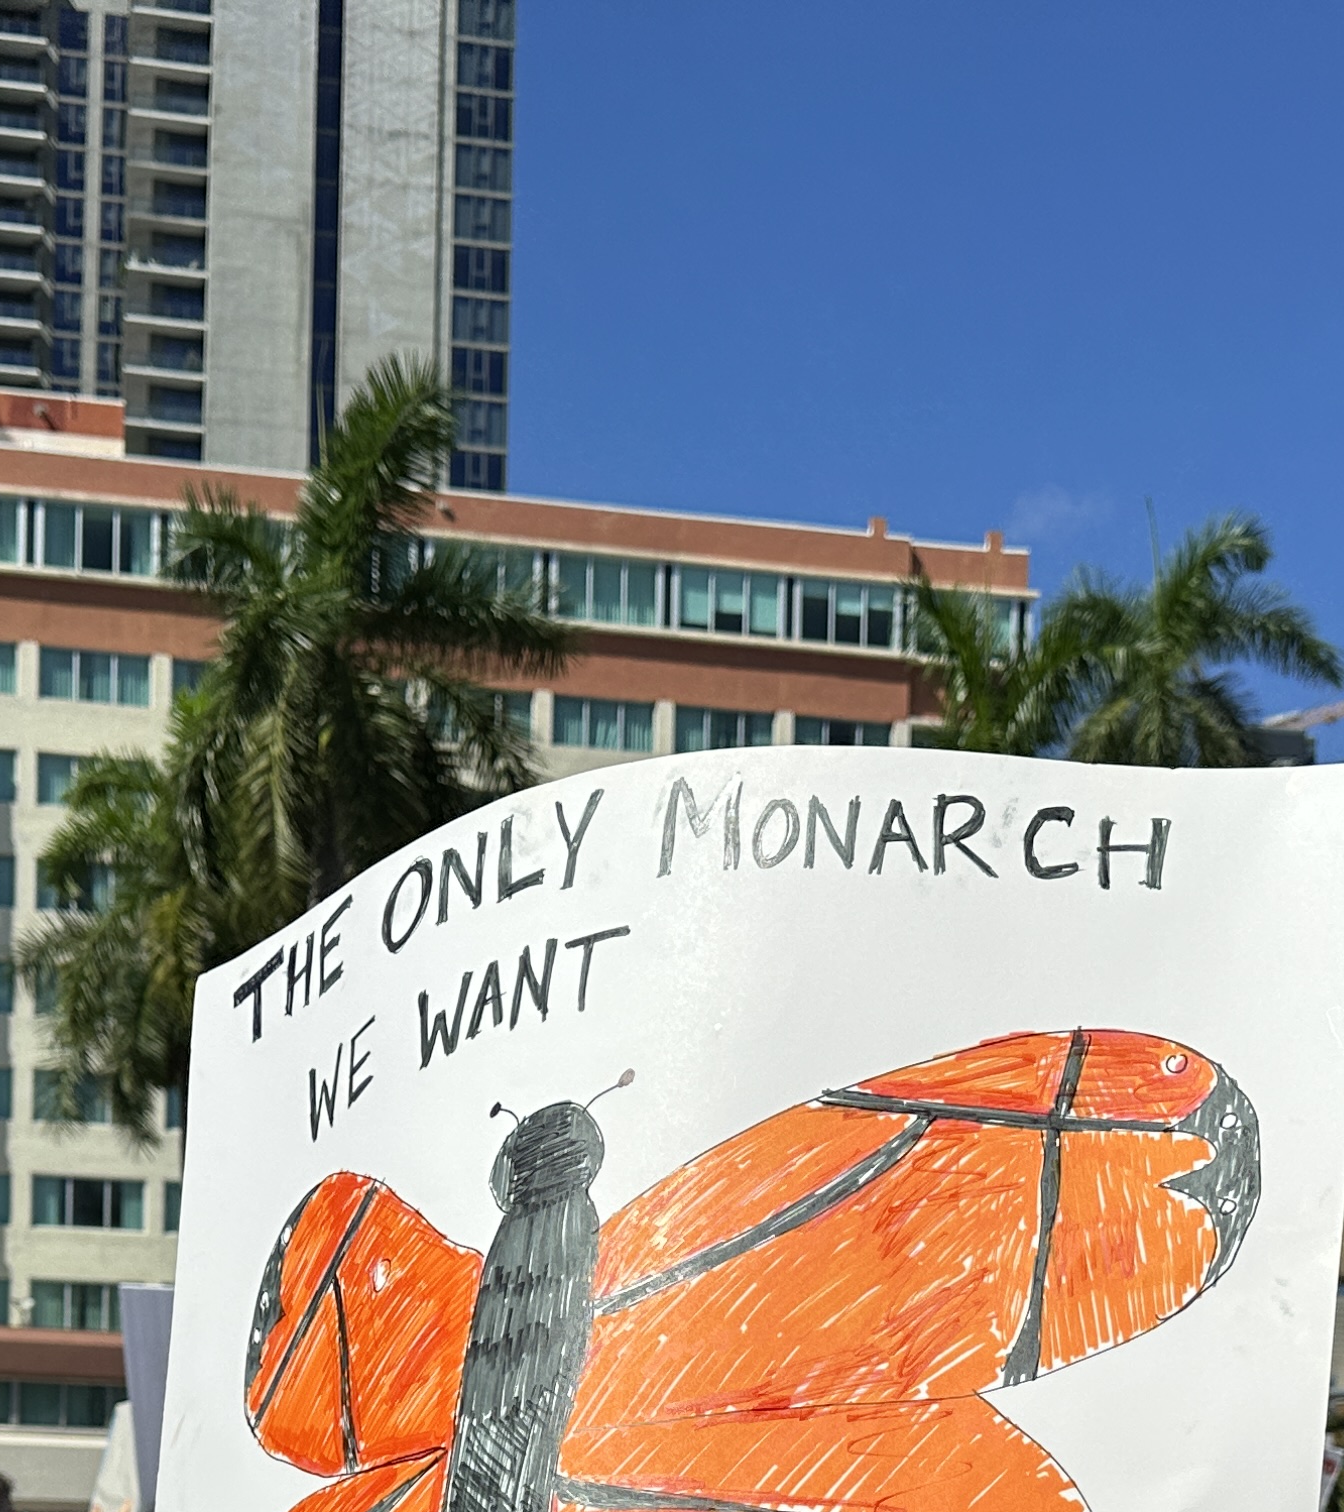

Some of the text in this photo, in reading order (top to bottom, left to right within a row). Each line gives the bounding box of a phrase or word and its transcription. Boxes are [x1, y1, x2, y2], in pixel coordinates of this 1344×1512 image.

[233, 771, 1172, 1043] THE ONLY MONARCH
[309, 925, 631, 1142] WE WANT
